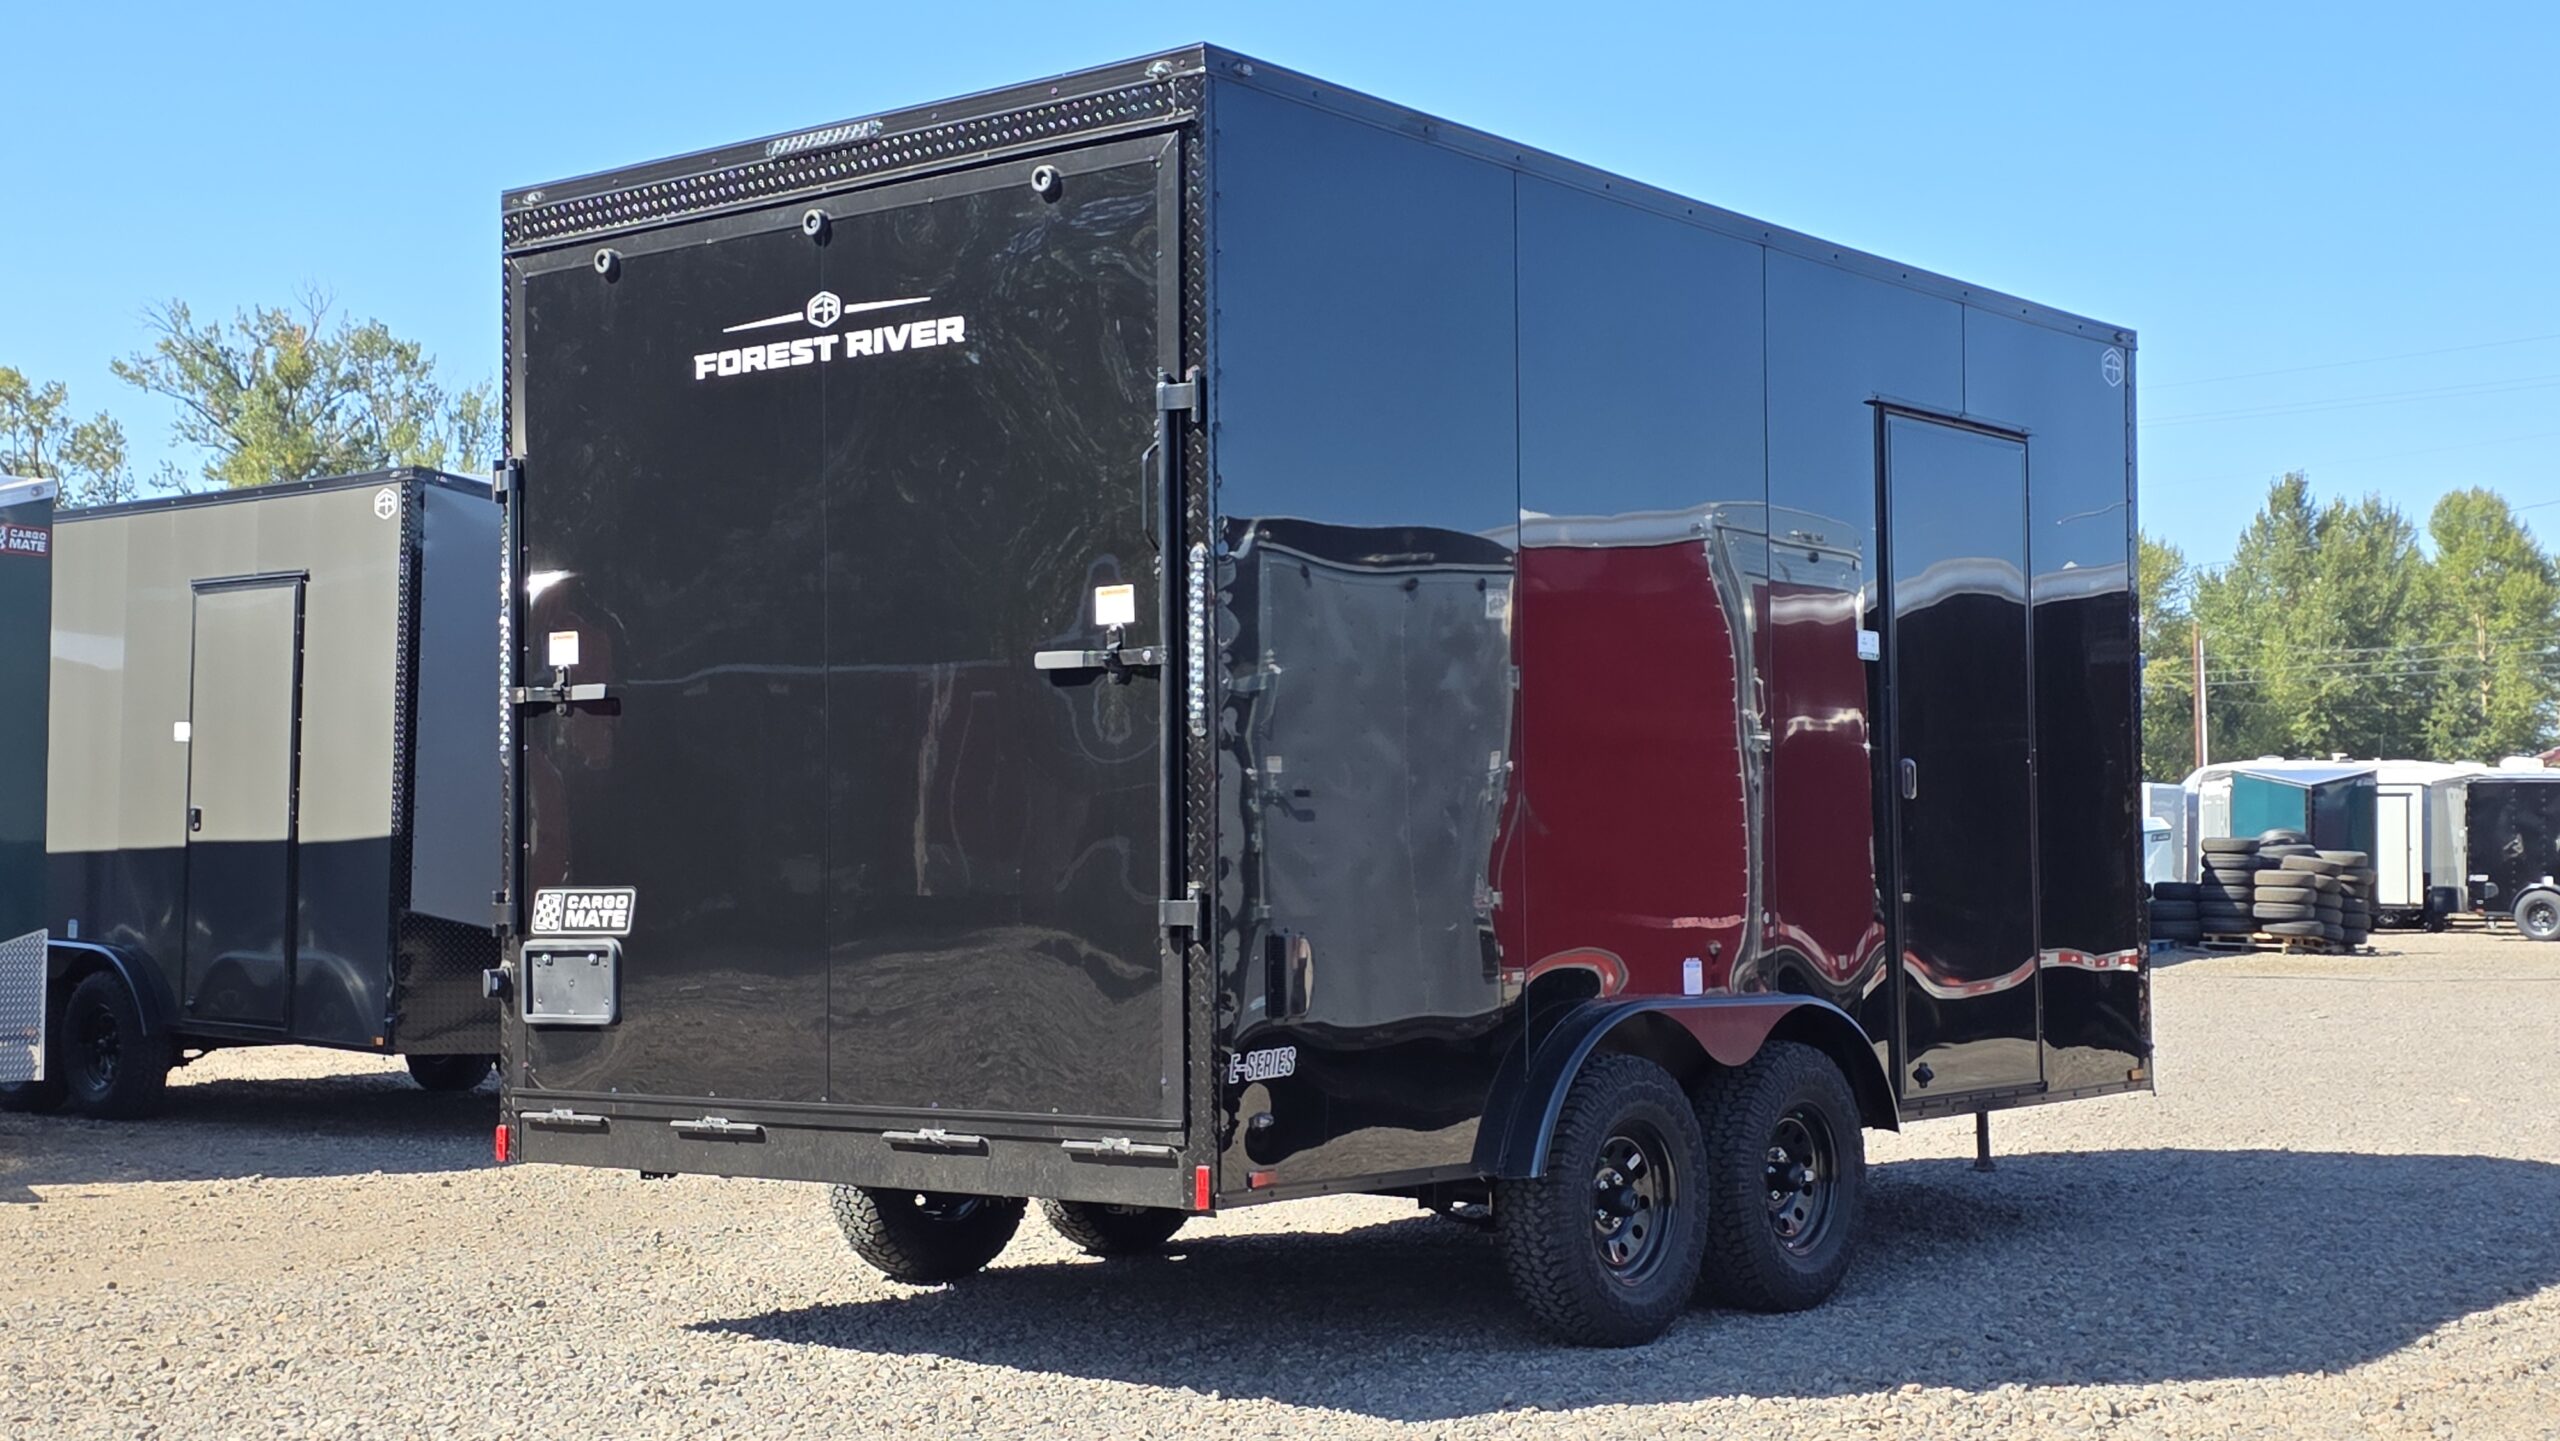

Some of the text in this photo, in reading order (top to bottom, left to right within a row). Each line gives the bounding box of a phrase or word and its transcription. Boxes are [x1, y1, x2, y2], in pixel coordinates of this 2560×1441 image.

[694, 316, 966, 380] FOREST RIVER
[10, 529, 47, 540] CARGO
[9, 538, 46, 552] MATE
[567, 895, 629, 909] CARGO
[565, 910, 627, 927] MATE
[1228, 1046, 1297, 1084] E-SERIES
